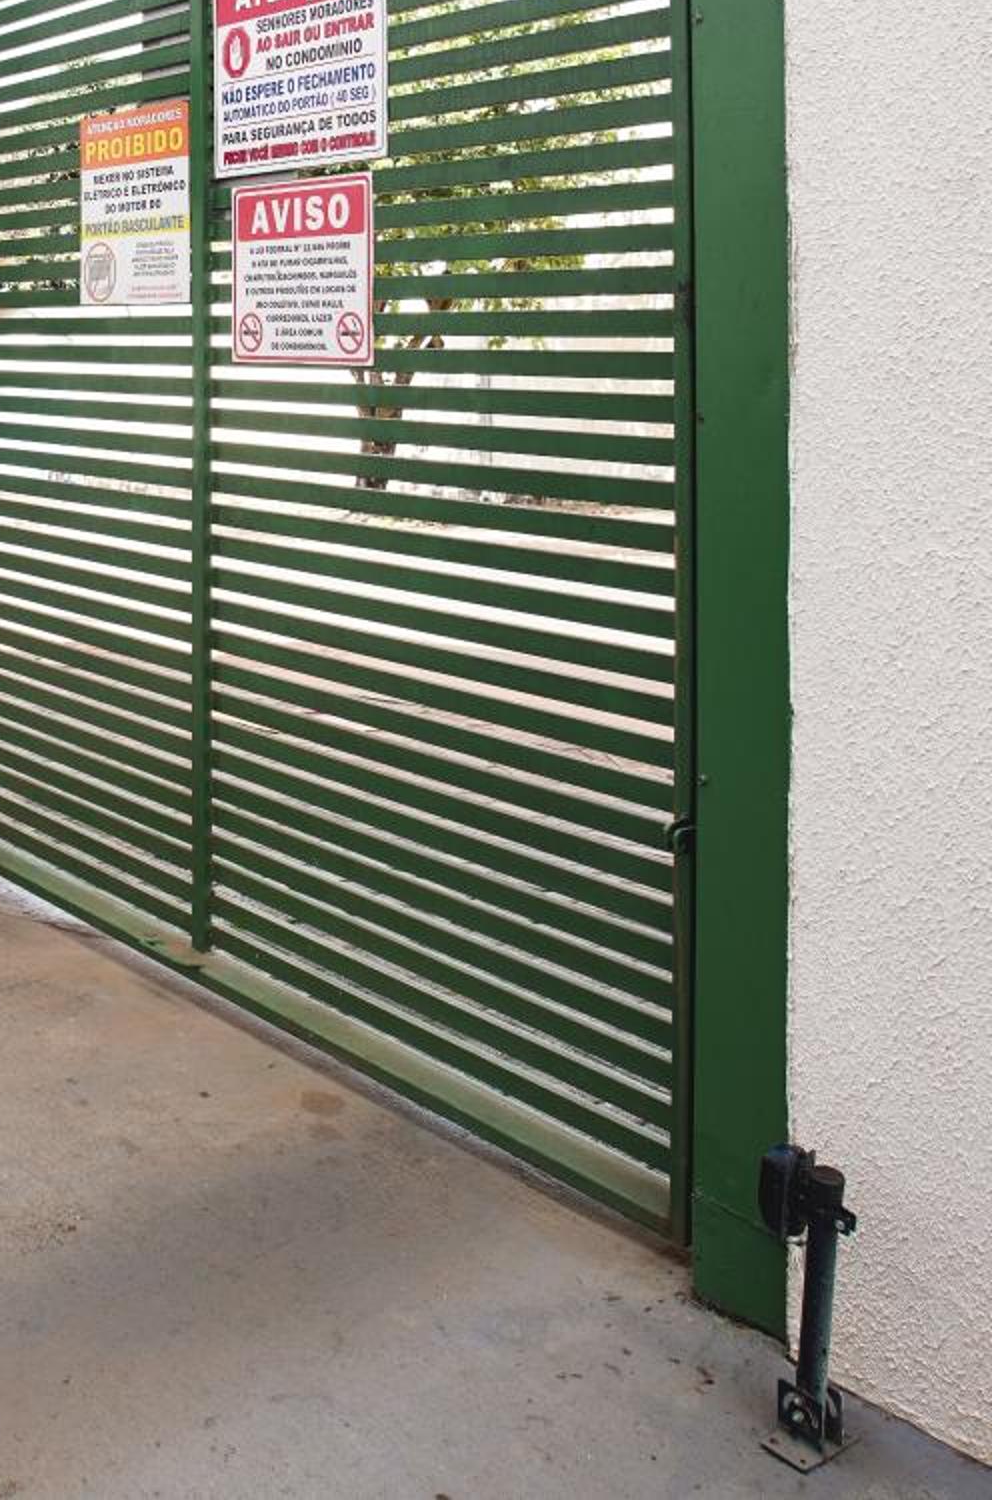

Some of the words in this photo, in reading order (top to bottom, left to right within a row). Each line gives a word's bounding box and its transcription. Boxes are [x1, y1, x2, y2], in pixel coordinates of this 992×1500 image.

[256, 9, 306, 34] SENHORES
[256, 36, 272, 53] AO
[275, 27, 301, 49] SAIR
[303, 24, 321, 41] OU
[324, 13, 375, 37] ENTRAR
[266, 55, 282, 70] NO
[222, 84, 243, 106] NÃO
[246, 81, 284, 102] ESPERE
[287, 78, 295, 94] O
[297, 63, 376, 92] FECHAMENTO
[278, 100, 290, 113] DO
[350, 85, 369, 101] SEG
[222, 129, 248, 146] PARA
[251, 119, 315, 141] SEGURANÇA
[318, 115, 333, 131] DE
[337, 109, 377, 128] TODOS
[85, 126, 184, 165] PROIBIDO
[122, 170, 134, 181] NO
[136, 165, 174, 179] SISTEMA
[118, 200, 147, 213] MOTOR
[251, 193, 350, 235] AVISO
